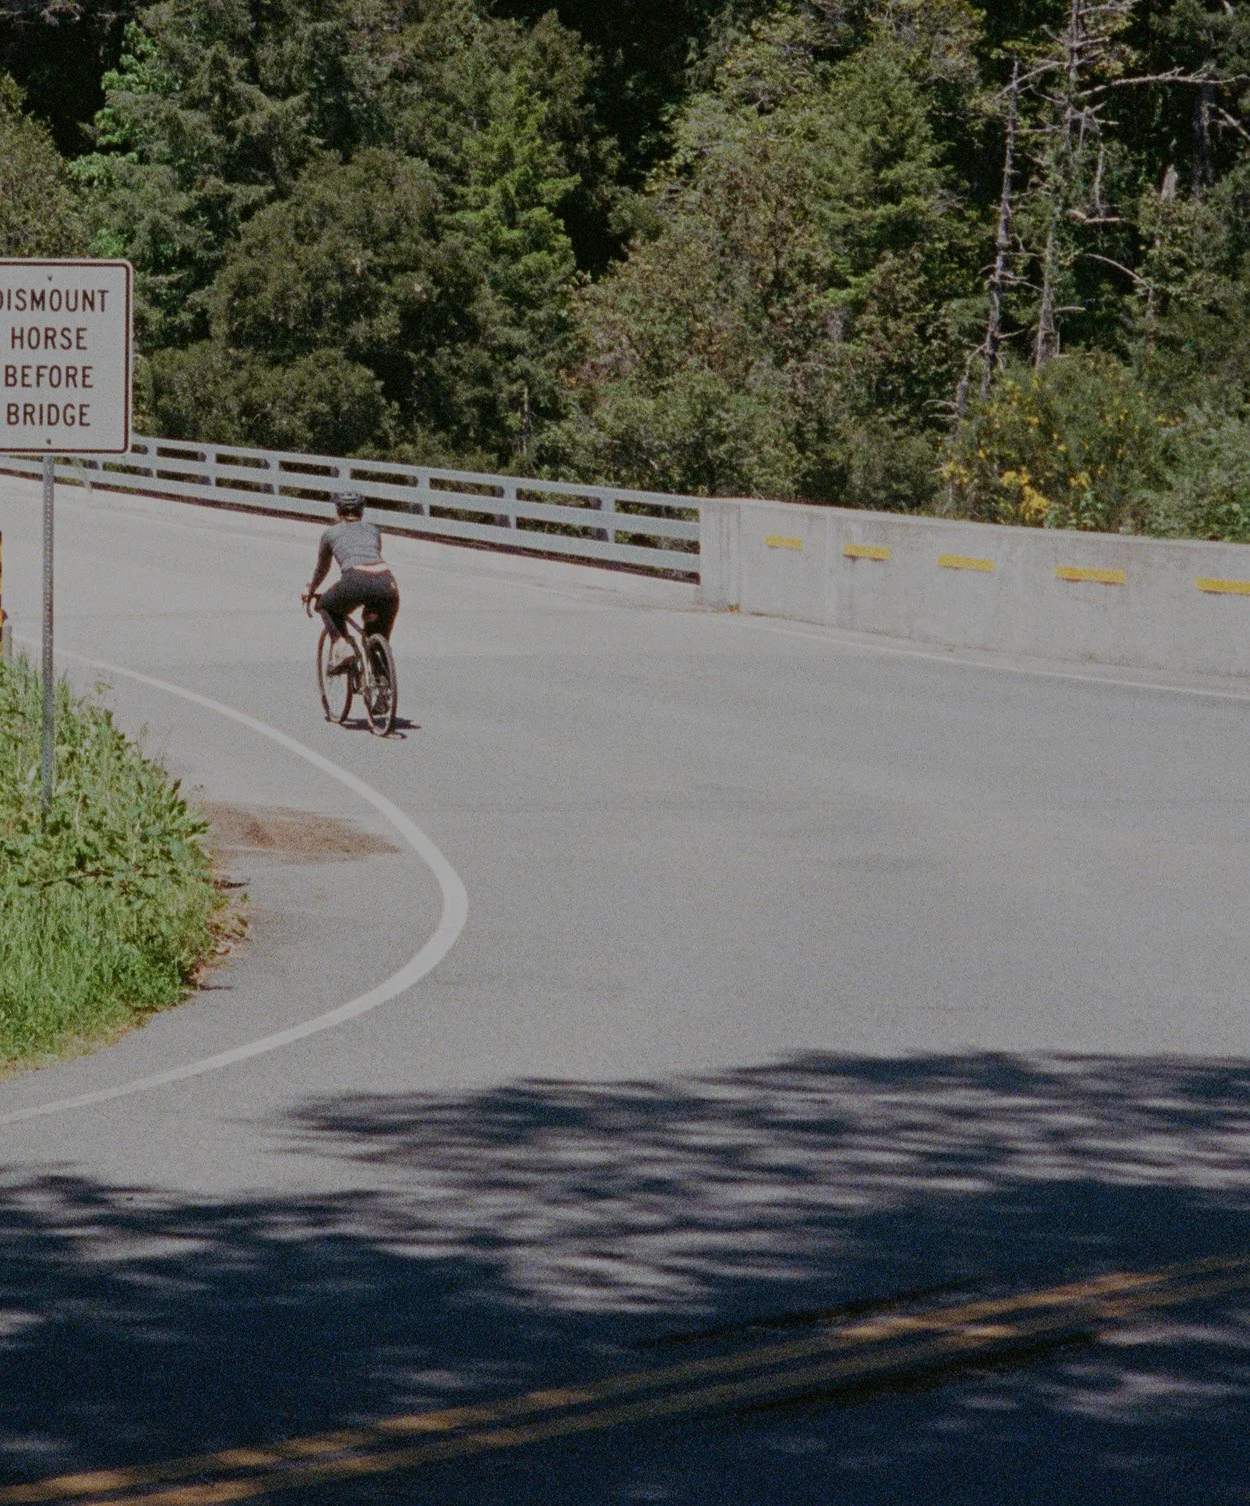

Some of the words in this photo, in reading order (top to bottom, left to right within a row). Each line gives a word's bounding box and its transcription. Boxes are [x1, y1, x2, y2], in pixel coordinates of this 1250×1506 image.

[10, 325, 88, 351] HORSE
[4, 364, 94, 389] BEFORE
[6, 402, 91, 427] BRIDGE
